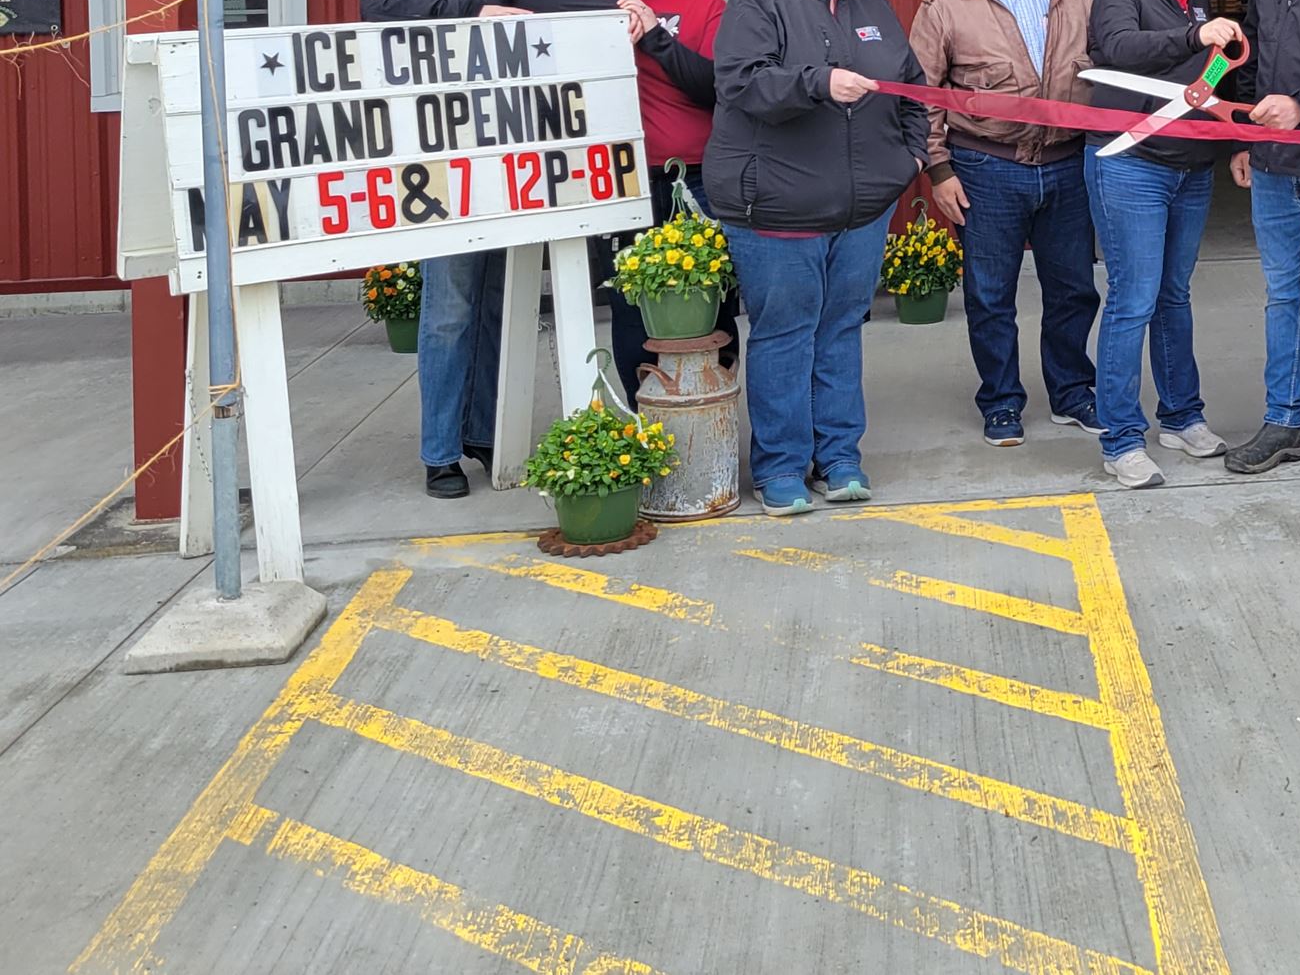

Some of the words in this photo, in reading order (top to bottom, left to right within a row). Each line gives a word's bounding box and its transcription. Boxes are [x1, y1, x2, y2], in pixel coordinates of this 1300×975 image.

[293, 30, 362, 94] ICE
[382, 21, 531, 86] CREAM
[238, 99, 394, 173] GRAND
[416, 82, 588, 153] OPENING
[502, 142, 636, 211] 12P-8P
